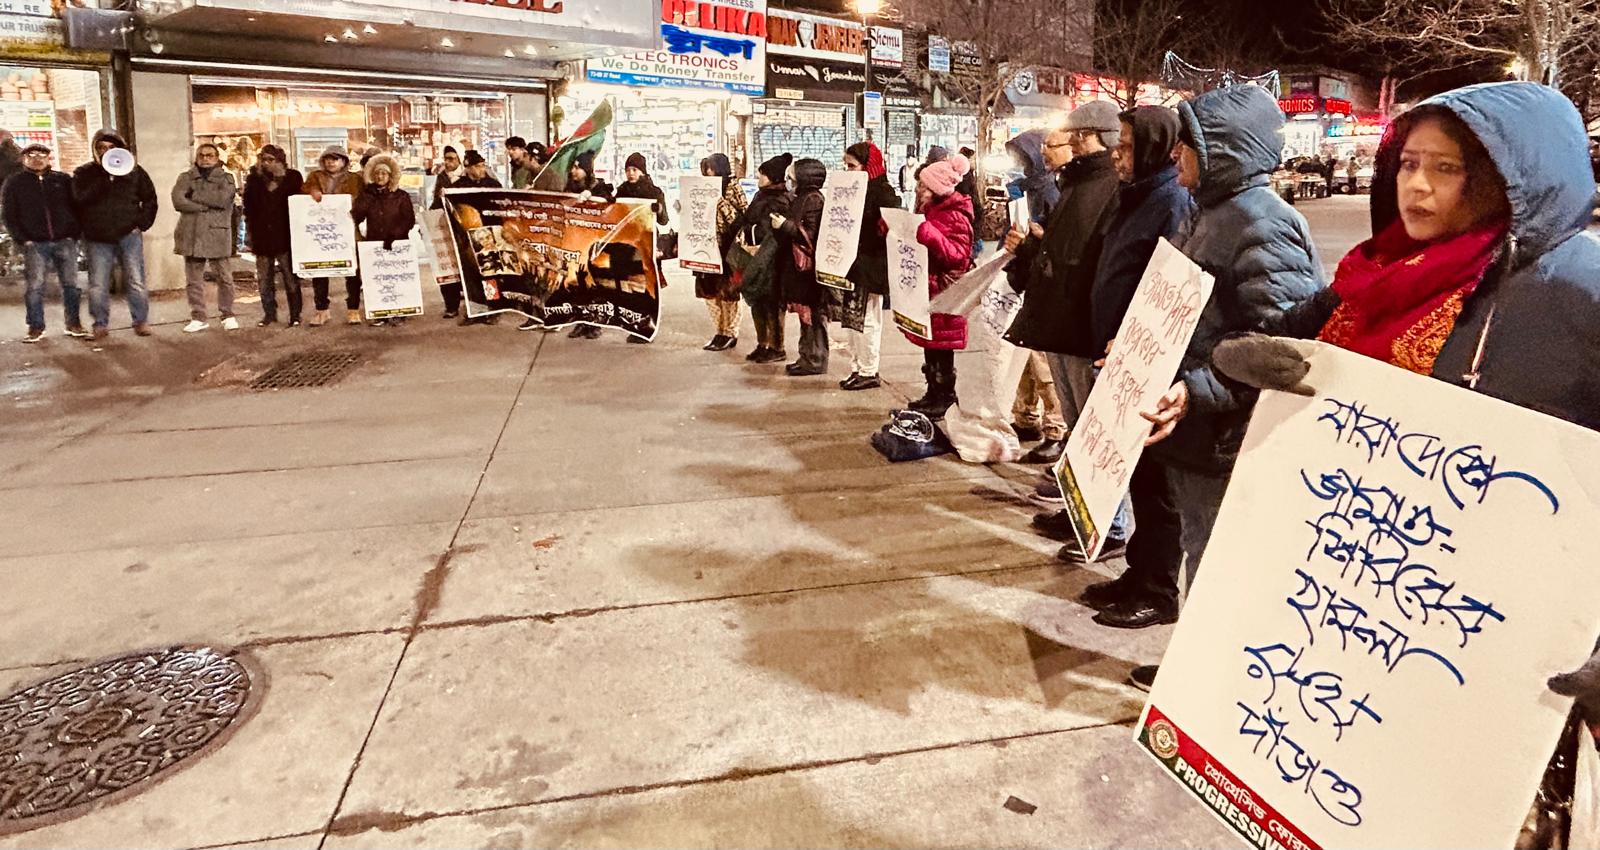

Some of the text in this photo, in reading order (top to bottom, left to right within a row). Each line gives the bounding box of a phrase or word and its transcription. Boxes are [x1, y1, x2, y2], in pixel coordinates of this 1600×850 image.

[0, 22, 15, 31] UR
[602, 57, 755, 82] We Do Money Transfer
[1279, 99, 1315, 113] RONICS
[1174, 757, 1284, 850] PROGRESSIV
